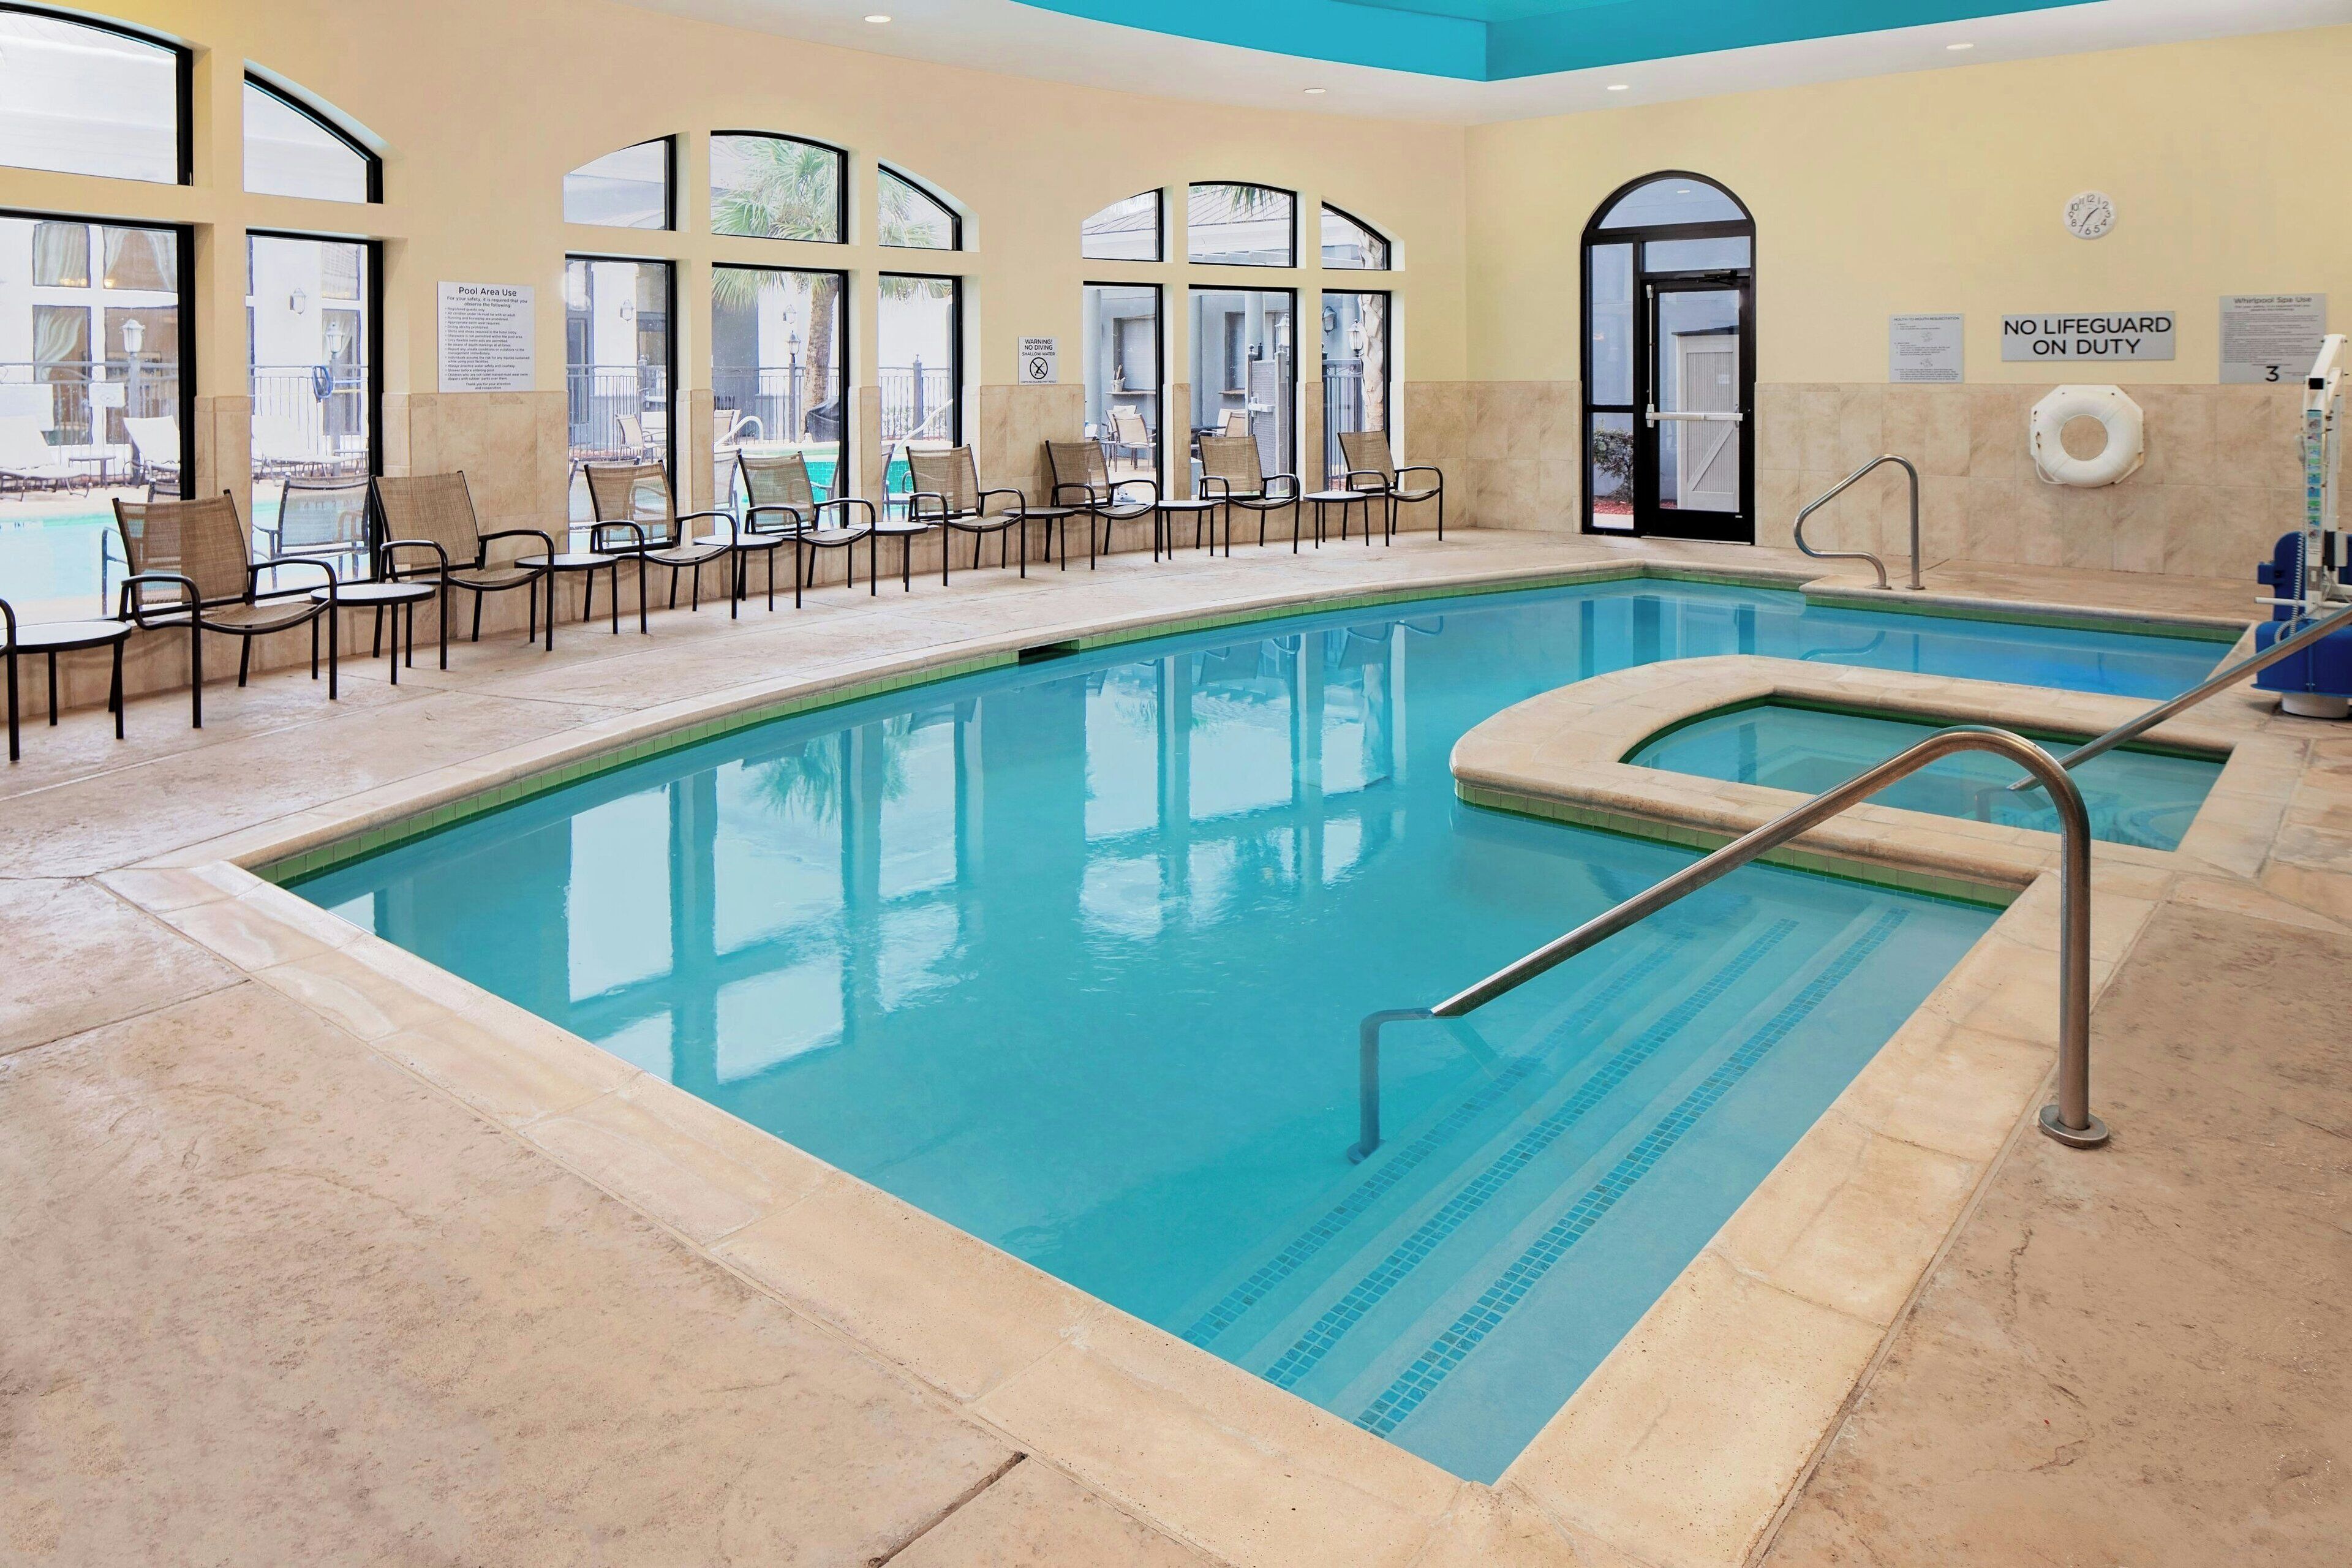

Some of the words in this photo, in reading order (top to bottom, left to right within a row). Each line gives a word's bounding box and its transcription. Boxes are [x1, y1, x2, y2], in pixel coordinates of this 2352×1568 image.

[2004, 320, 2037, 335] NO
[2044, 317, 2173, 334] LIFEGUARD
[2032, 339, 2067, 355] ON
[2076, 338, 2141, 355] DUTY
[2265, 366, 2279, 382] 3
